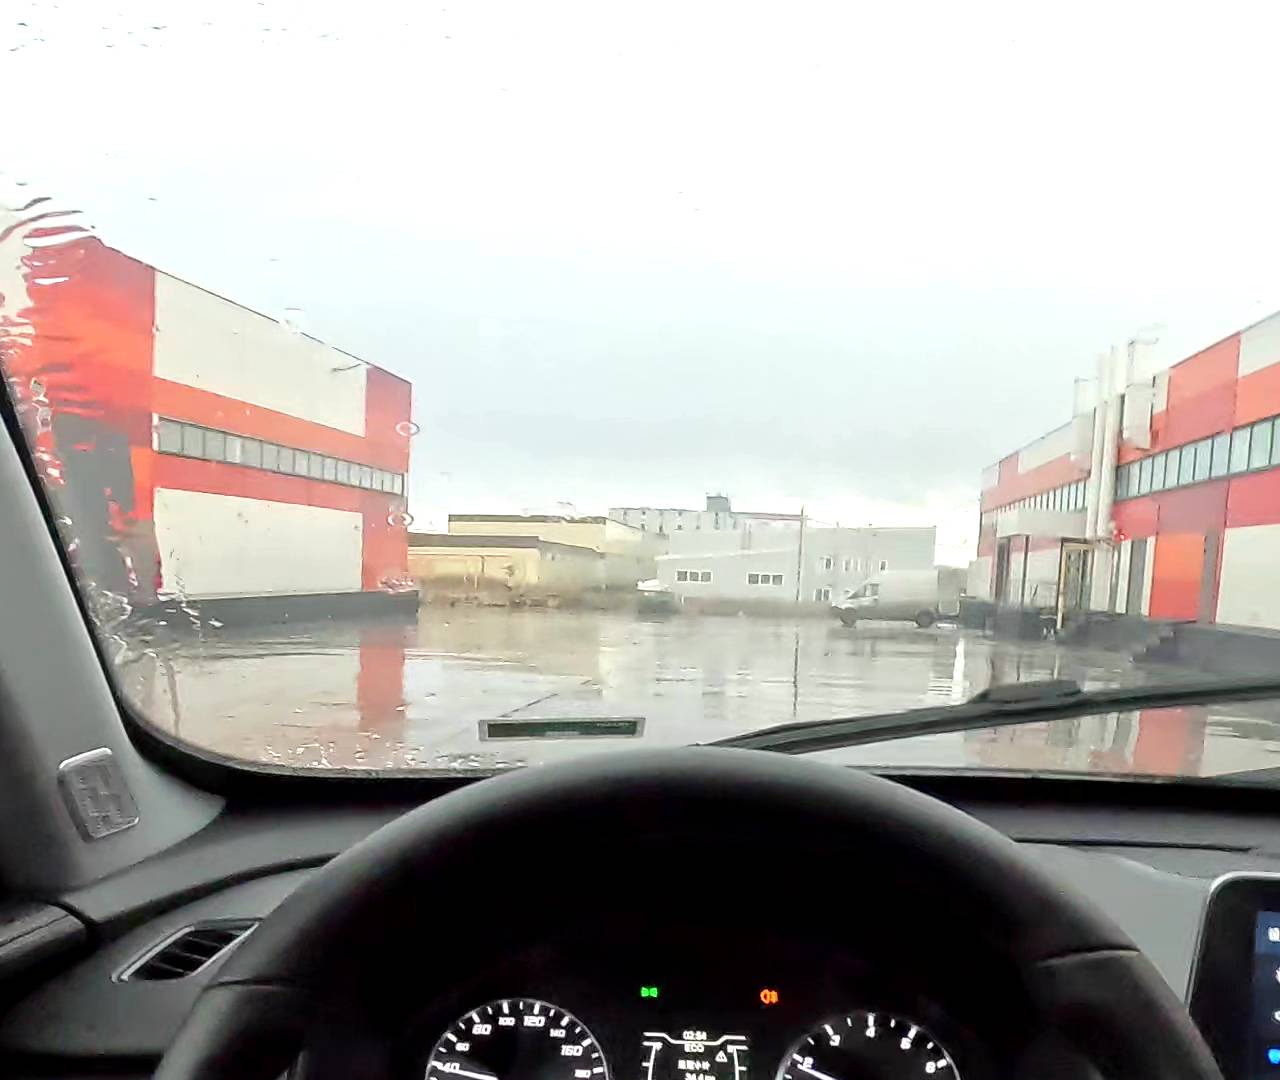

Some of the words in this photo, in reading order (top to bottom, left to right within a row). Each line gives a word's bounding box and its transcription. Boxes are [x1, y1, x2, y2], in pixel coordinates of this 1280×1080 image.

[523, 1015, 545, 1027] 120
[865, 1026, 876, 1038] 4
[829, 1034, 841, 1046] 3
[802, 1056, 814, 1068] 2
